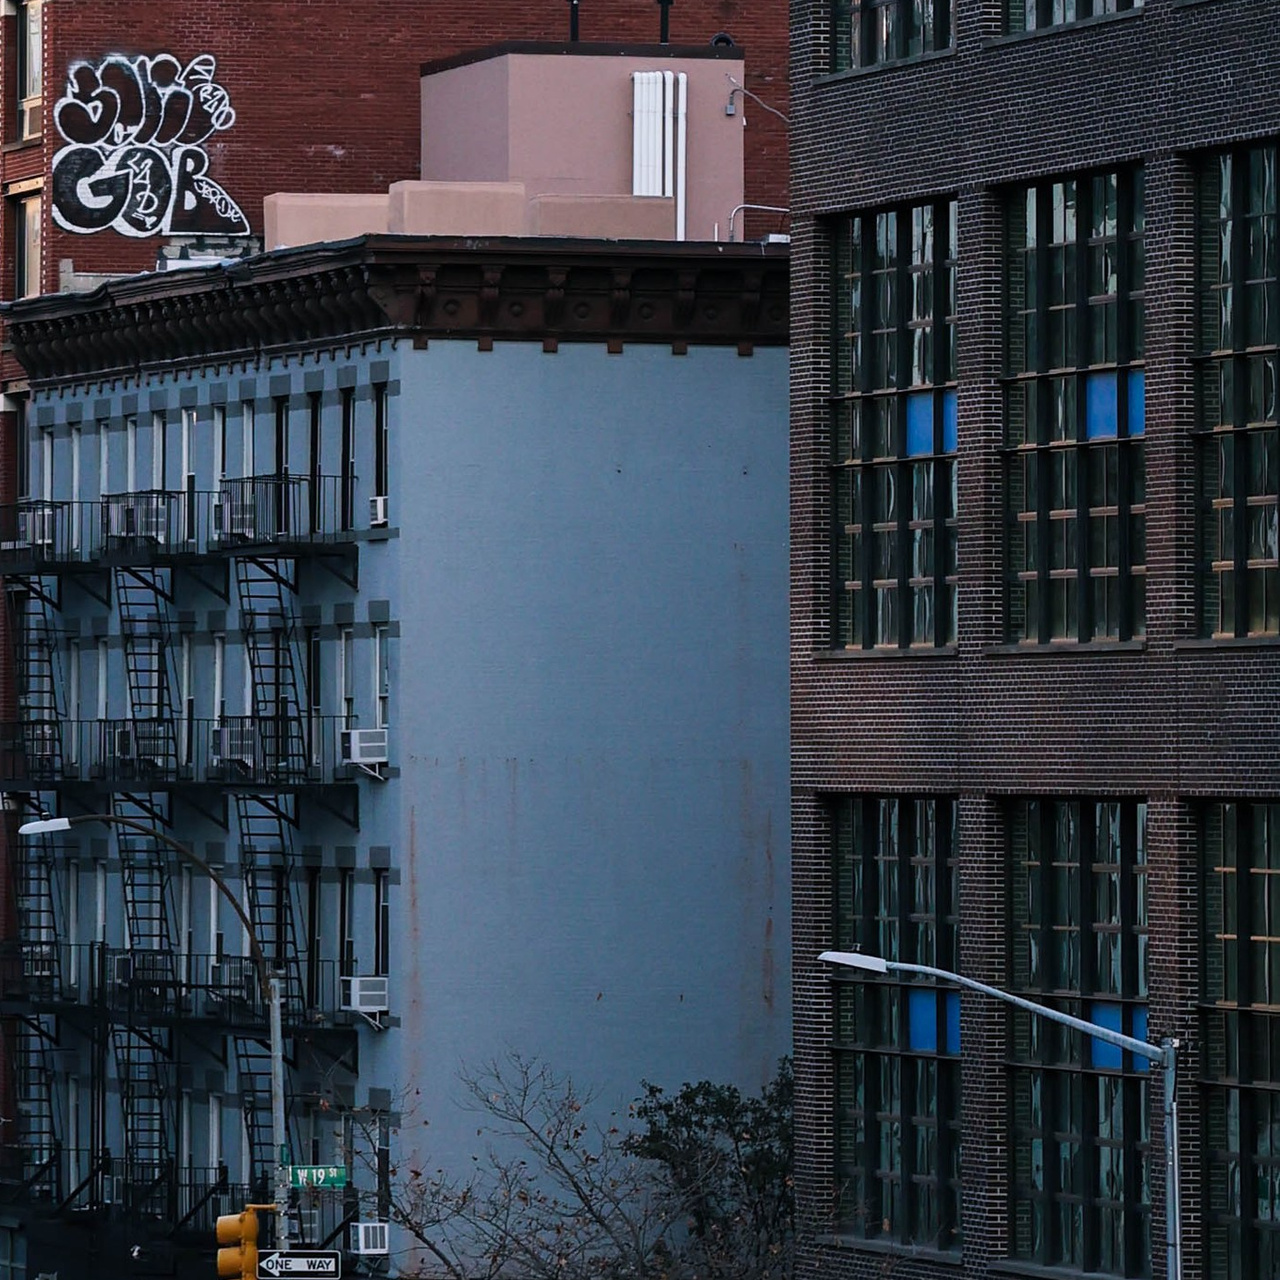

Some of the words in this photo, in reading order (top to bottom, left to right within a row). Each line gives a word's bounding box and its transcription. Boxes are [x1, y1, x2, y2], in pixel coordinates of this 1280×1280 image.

[297, 1169, 308, 1185] W
[312, 1169, 325, 1184] 19
[265, 1259, 292, 1270] ONE
[306, 1259, 332, 1270] WAY
